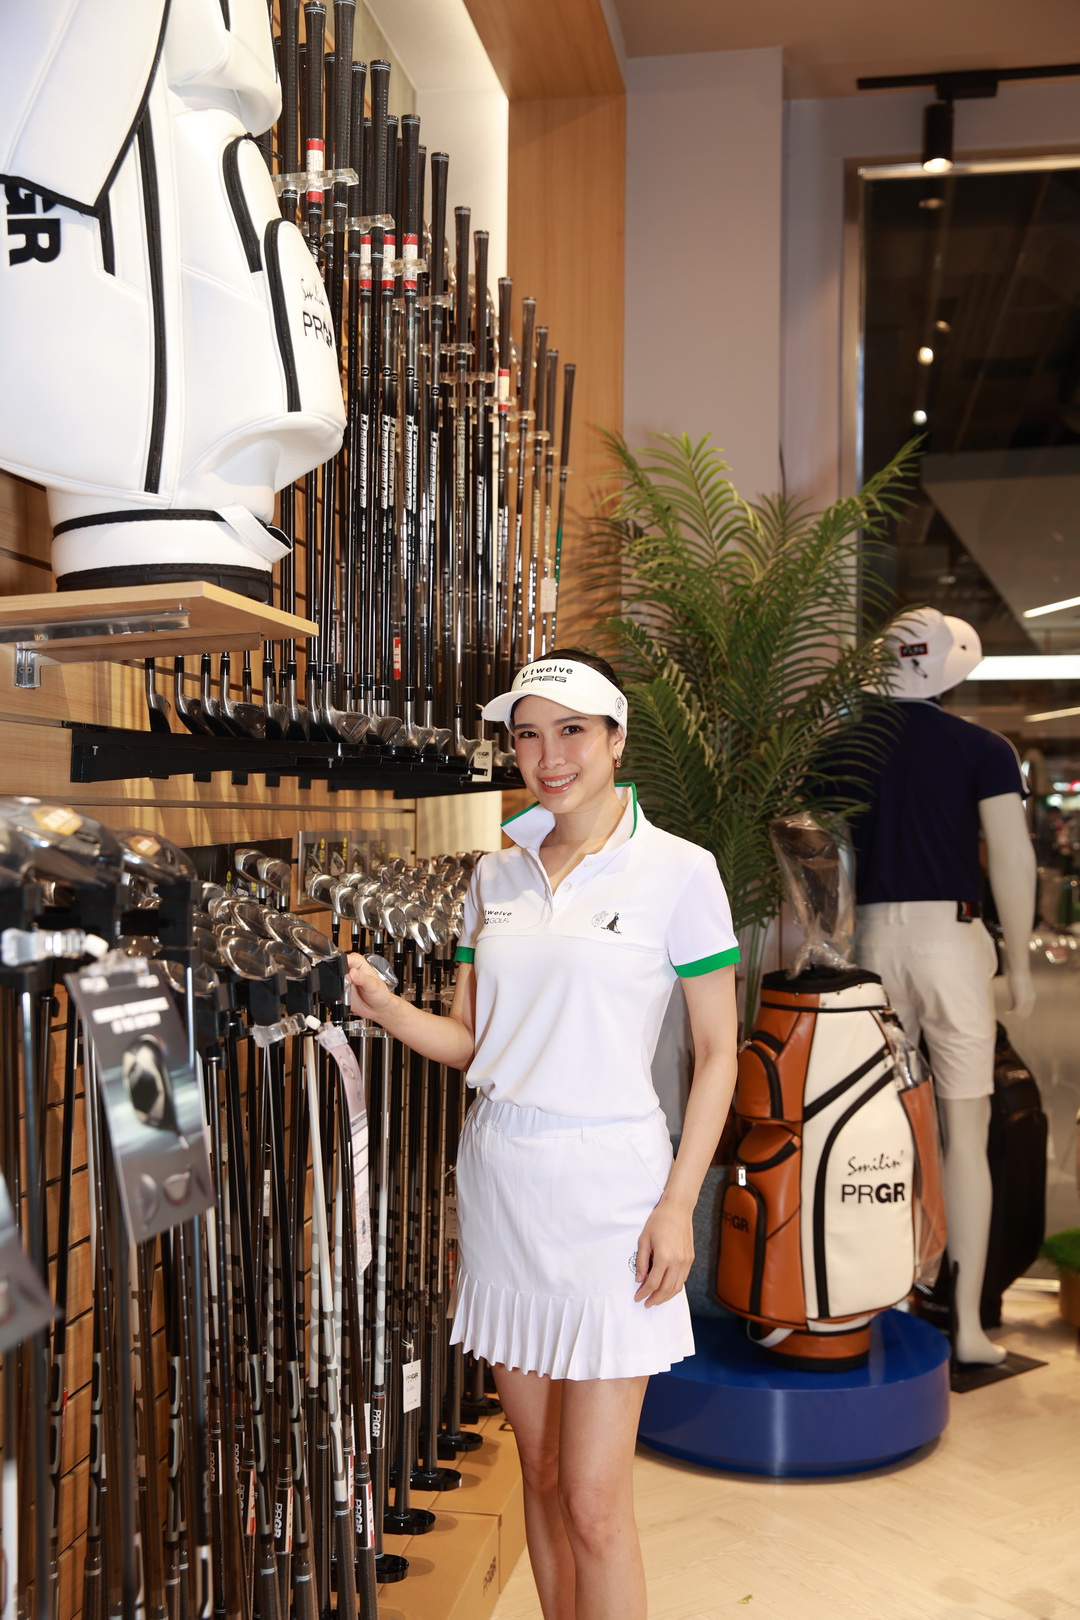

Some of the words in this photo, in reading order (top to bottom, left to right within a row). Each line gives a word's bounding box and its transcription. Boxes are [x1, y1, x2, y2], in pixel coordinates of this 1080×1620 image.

[360, 413, 368, 508] Diamana
[381, 413, 390, 510] Diamana
[429, 431, 438, 521] Diamana
[841, 1182, 906, 1204] PRGR
[372, 1409, 382, 1438] PRGR
[274, 1502, 283, 1539] PRGR
[355, 1498, 364, 1534] PRGR
